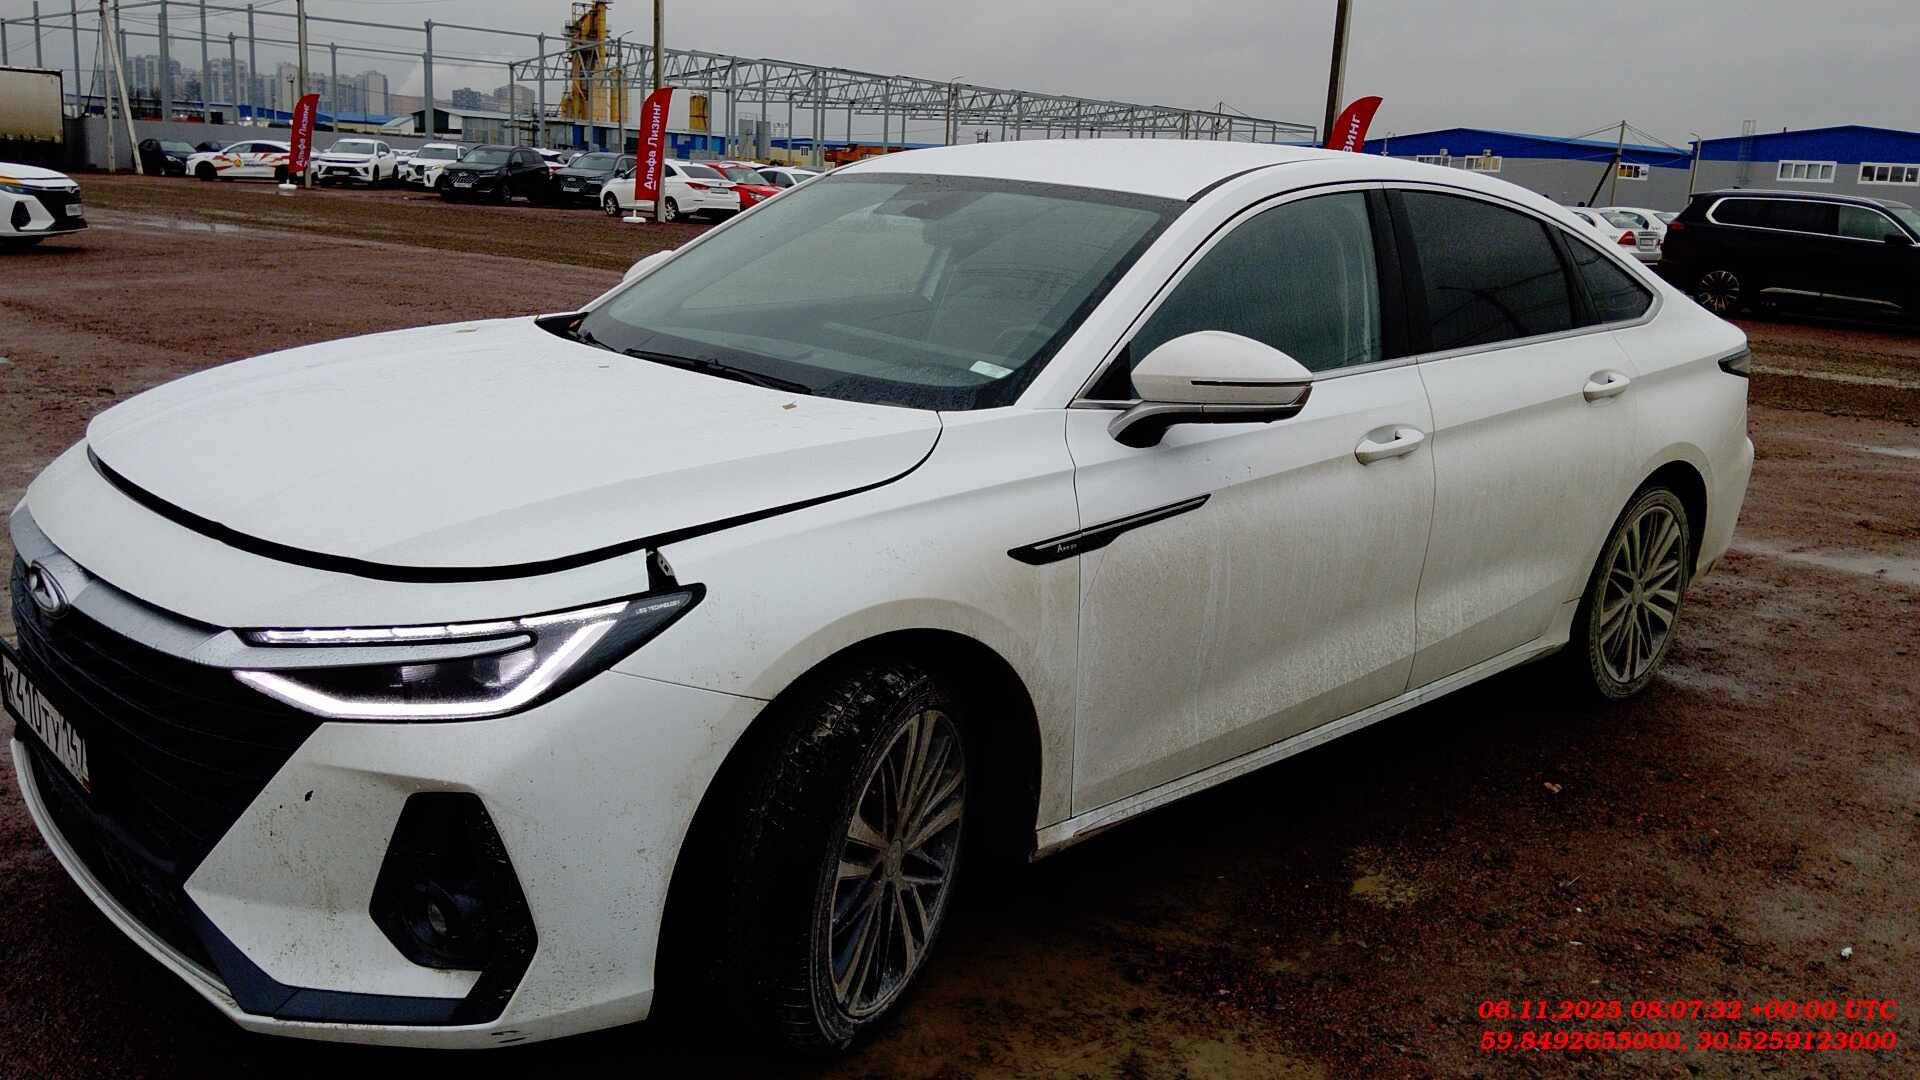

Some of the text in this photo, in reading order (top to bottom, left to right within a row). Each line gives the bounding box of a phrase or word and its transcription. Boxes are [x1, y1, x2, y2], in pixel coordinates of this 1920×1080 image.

[643, 103, 661, 190] Альфа Лизинг
[1343, 113, 1360, 152] зинг
